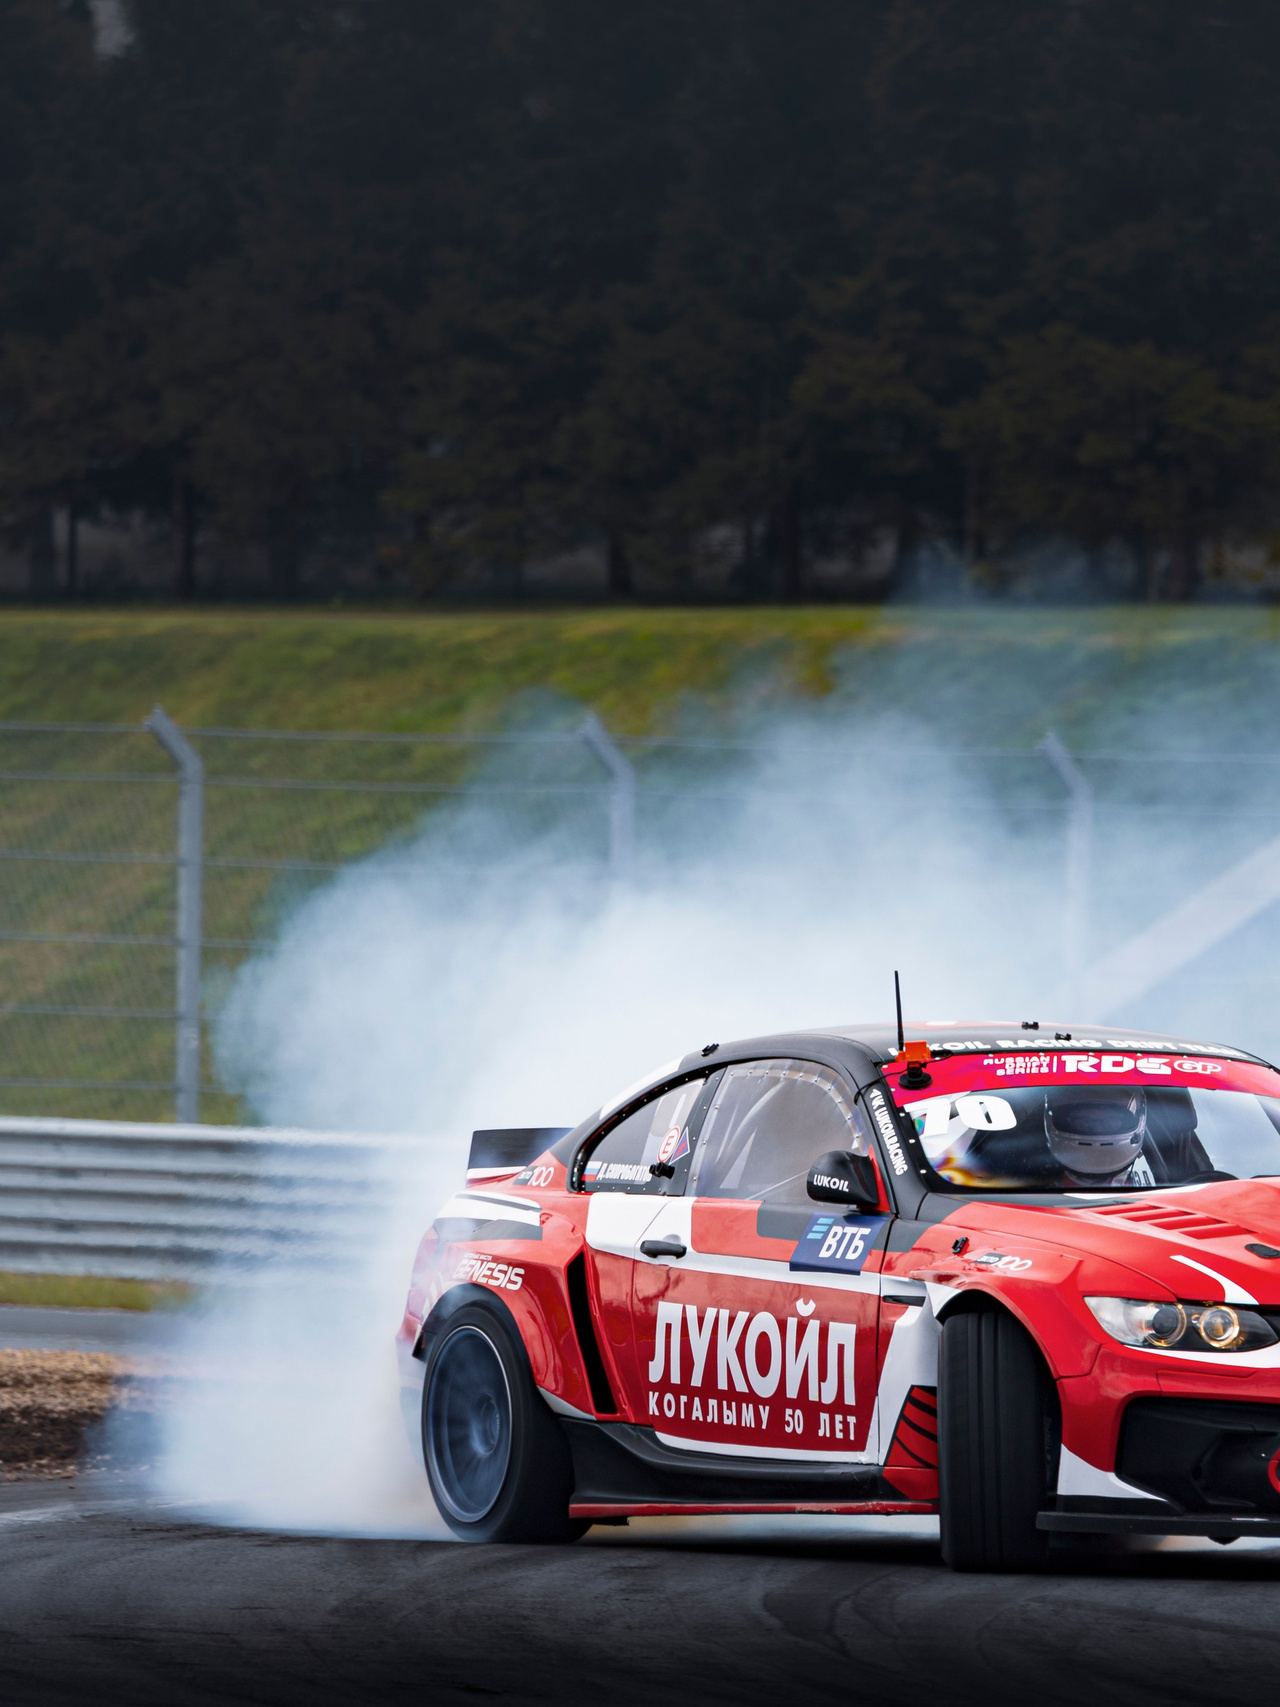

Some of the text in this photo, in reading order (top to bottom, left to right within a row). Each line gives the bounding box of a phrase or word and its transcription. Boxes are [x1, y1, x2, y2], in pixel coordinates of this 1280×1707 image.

[996, 1039, 1103, 1048] RACING
[1106, 1040, 1178, 1051] DRIFT
[983, 1056, 1051, 1066] RUSSIAN
[1004, 1061, 1050, 1069] DRIFT
[1061, 1055, 1223, 1075] RDS GP
[996, 1067, 1050, 1077] SERIES
[662, 1135, 675, 1155] E
[874, 1106, 909, 1176] LUKOILRACING
[527, 1166, 555, 1188] 100
[813, 1174, 850, 1193] LUKOIL
[818, 1225, 872, 1260] ВТБ
[990, 1255, 1033, 1271] 100
[452, 1258, 525, 1291] GENESIS
[648, 1297, 857, 1406] ЛУКОЙЛ
[648, 1391, 857, 1441] КОГАЛЫМУ 50 ЛЕТ
